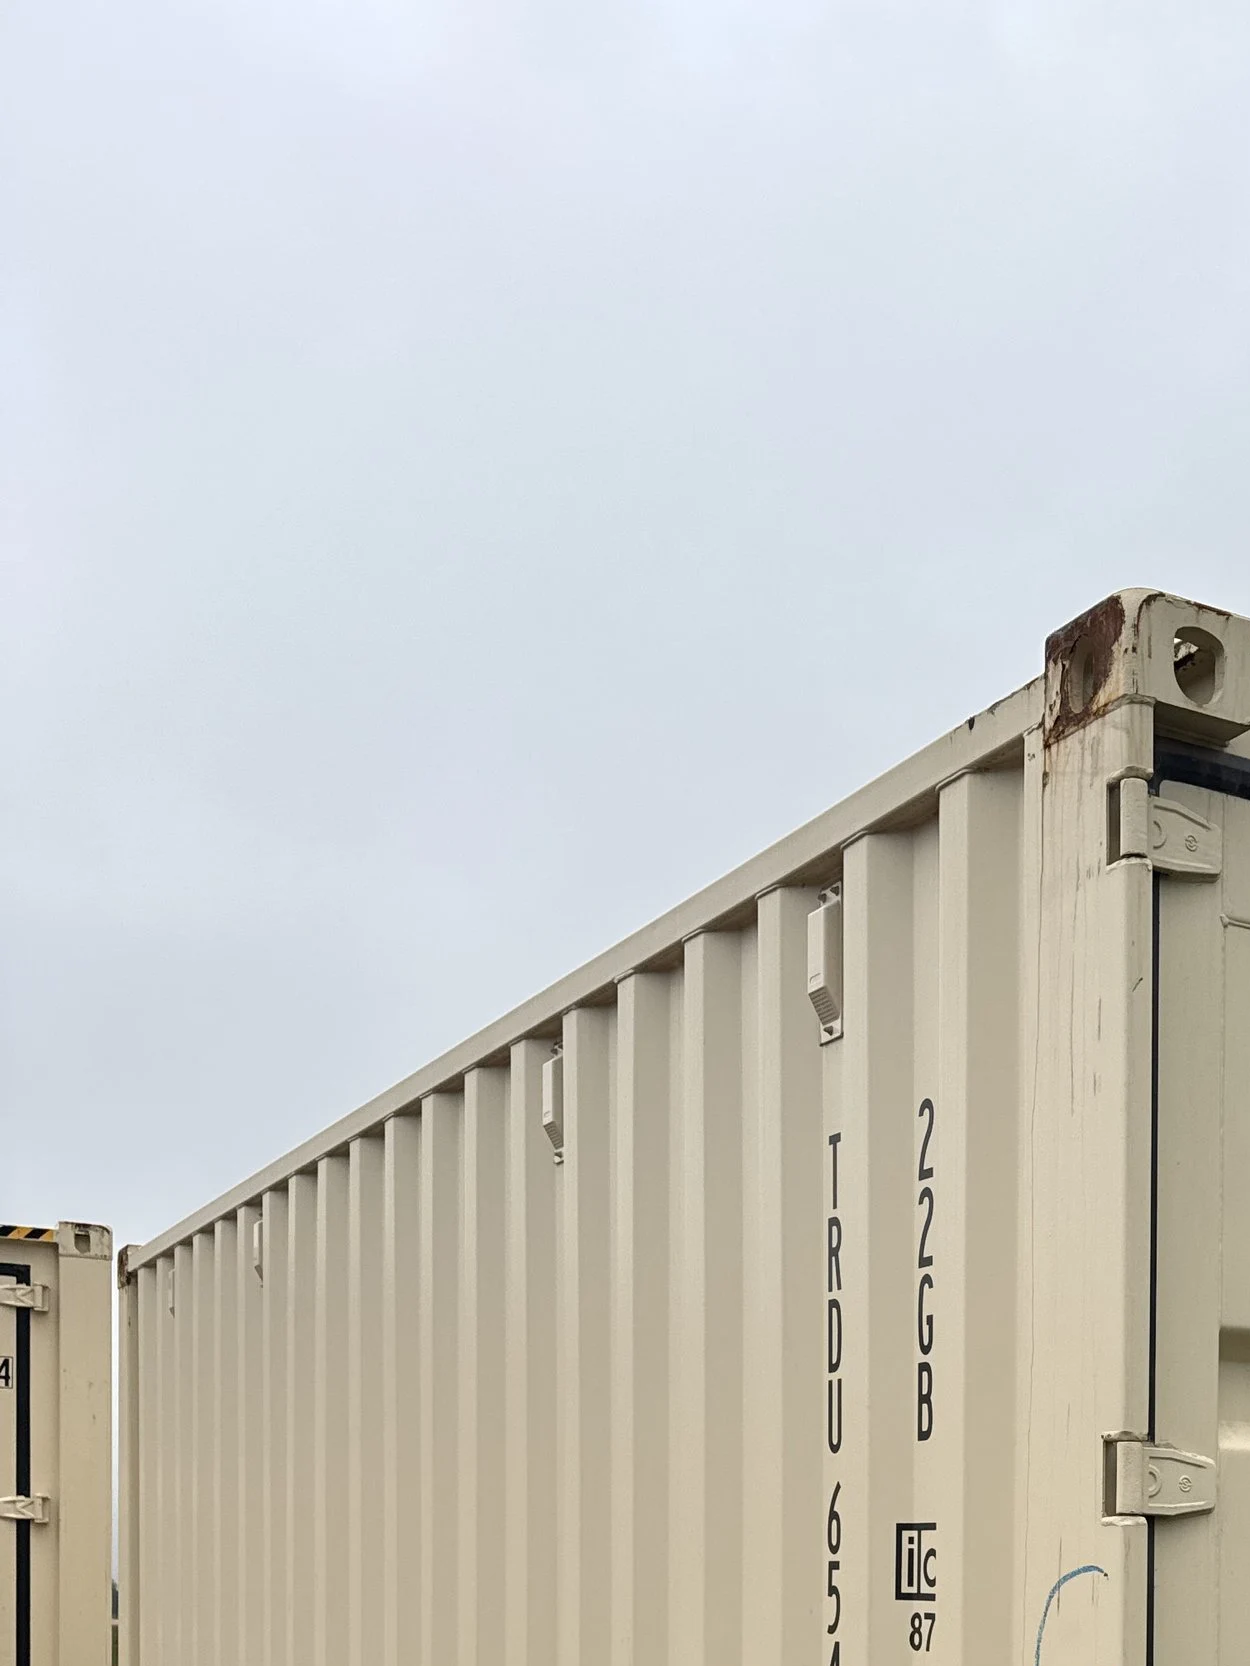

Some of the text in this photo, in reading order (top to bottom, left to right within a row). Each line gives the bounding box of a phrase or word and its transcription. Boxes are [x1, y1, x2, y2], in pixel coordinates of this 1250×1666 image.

[827, 1131, 842, 1454] TRDU
[917, 1097, 935, 1442] 22GB
[909, 1612, 936, 1652] 87
